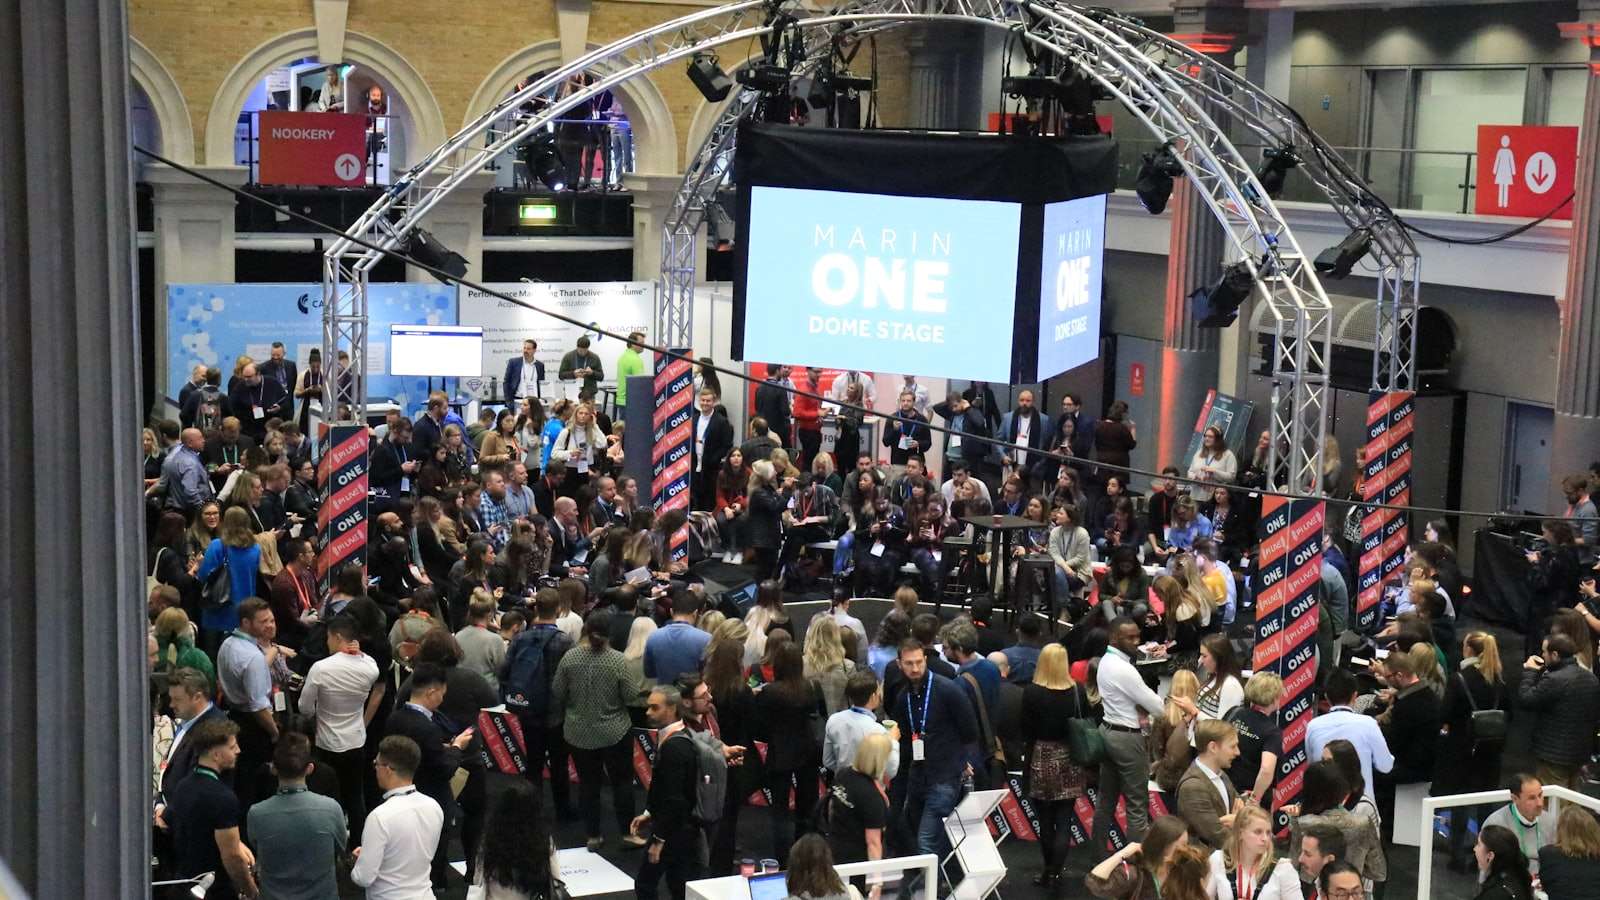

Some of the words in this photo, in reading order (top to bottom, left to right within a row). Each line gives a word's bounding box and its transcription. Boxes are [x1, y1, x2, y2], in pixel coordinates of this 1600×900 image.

[272, 127, 336, 140] NOOKERY
[814, 223, 951, 257] MARIN
[1057, 227, 1092, 257] MARIN
[811, 251, 949, 313] ONE
[1056, 255, 1091, 311] ONE
[808, 313, 871, 338] DOME
[876, 318, 945, 345] STAGE
[672, 377, 690, 393] ONE
[671, 412, 689, 427] ONE
[1394, 404, 1412, 421] ONE
[1371, 423, 1386, 438] ONE
[670, 446, 688, 461] ONE
[1392, 442, 1409, 459] ONE
[338, 464, 364, 486] ONE
[1369, 460, 1384, 476] ONE
[669, 480, 687, 496] ONE
[1389, 480, 1407, 497] ONE
[338, 510, 363, 532] ONE
[1266, 514, 1286, 534] ONE
[1387, 517, 1404, 535] ONE
[1365, 536, 1380, 550] ONE
[672, 548, 686, 561] NE
[1294, 542, 1319, 566] ONE
[1385, 555, 1402, 572] ONE
[1263, 567, 1283, 586] ONE
[1363, 574, 1378, 588] ONE
[1291, 594, 1315, 618] ONE
[1260, 619, 1280, 638] ONE
[1288, 646, 1312, 670] ONE
[1293, 674, 1308, 687] LIVE
[1285, 698, 1309, 721] ONE
[1290, 727, 1305, 738] LIVE
[494, 717, 506, 734] ONE
[504, 736, 516, 752] ONE
[514, 755, 526, 772] ONE
[639, 734, 652, 751] ONE
[481, 751, 493, 768] ONE
[1282, 750, 1306, 774] ONE
[1087, 788, 1097, 805] ON
[1010, 779, 1022, 797] ONE
[1021, 800, 1034, 817] ONE
[1032, 820, 1041, 837] ON
[994, 815, 1008, 833] ONE
[1070, 825, 1084, 844] ONE
[1109, 830, 1123, 849] ONE
